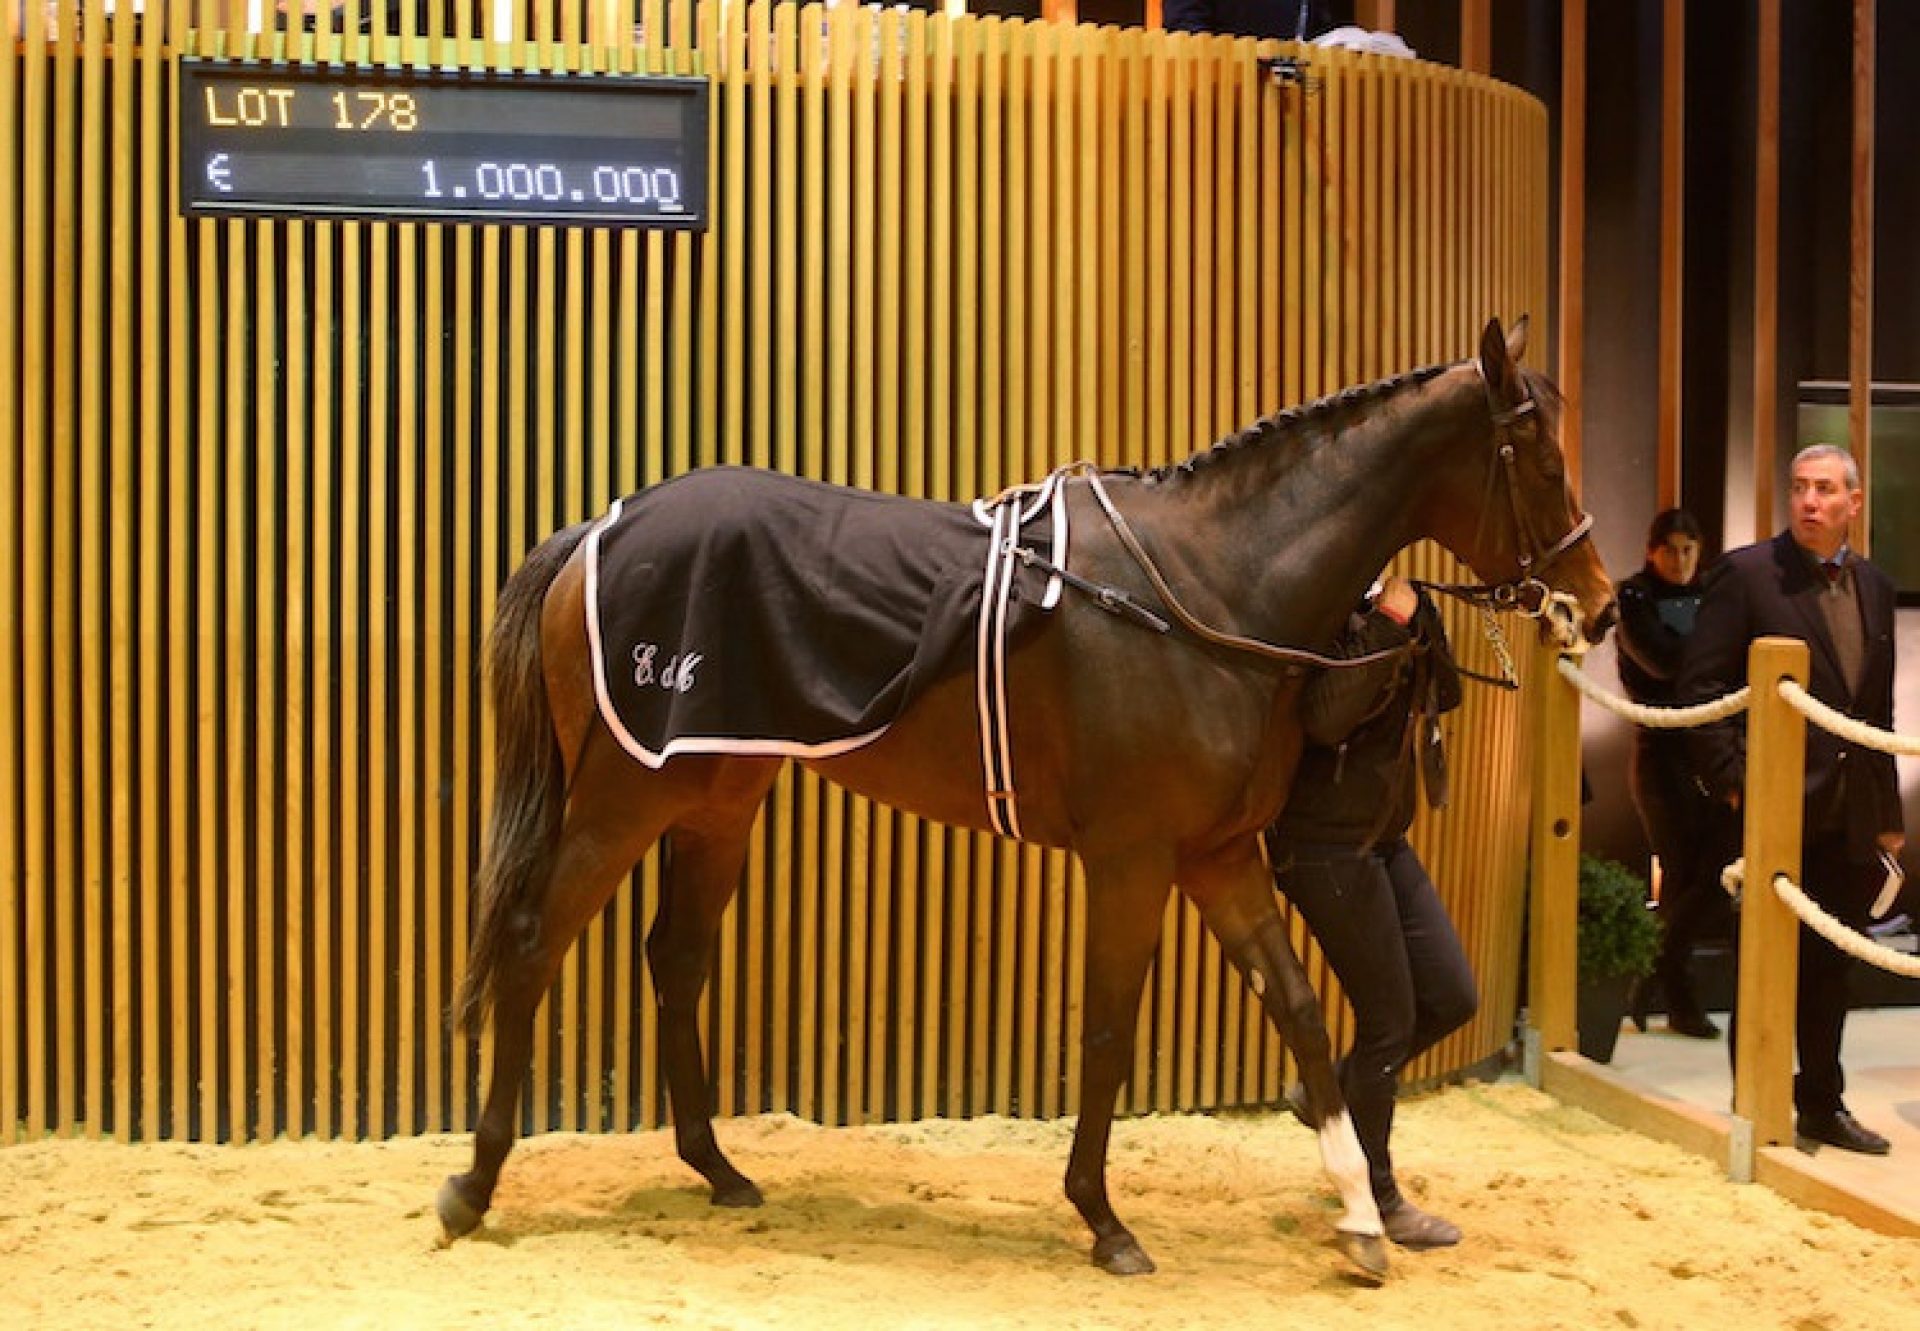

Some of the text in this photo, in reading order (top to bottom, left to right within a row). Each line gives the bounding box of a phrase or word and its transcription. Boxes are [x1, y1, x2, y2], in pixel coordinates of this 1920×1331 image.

[205, 86, 418, 131] LOT 178
[207, 153, 680, 204] € 1.000.000
